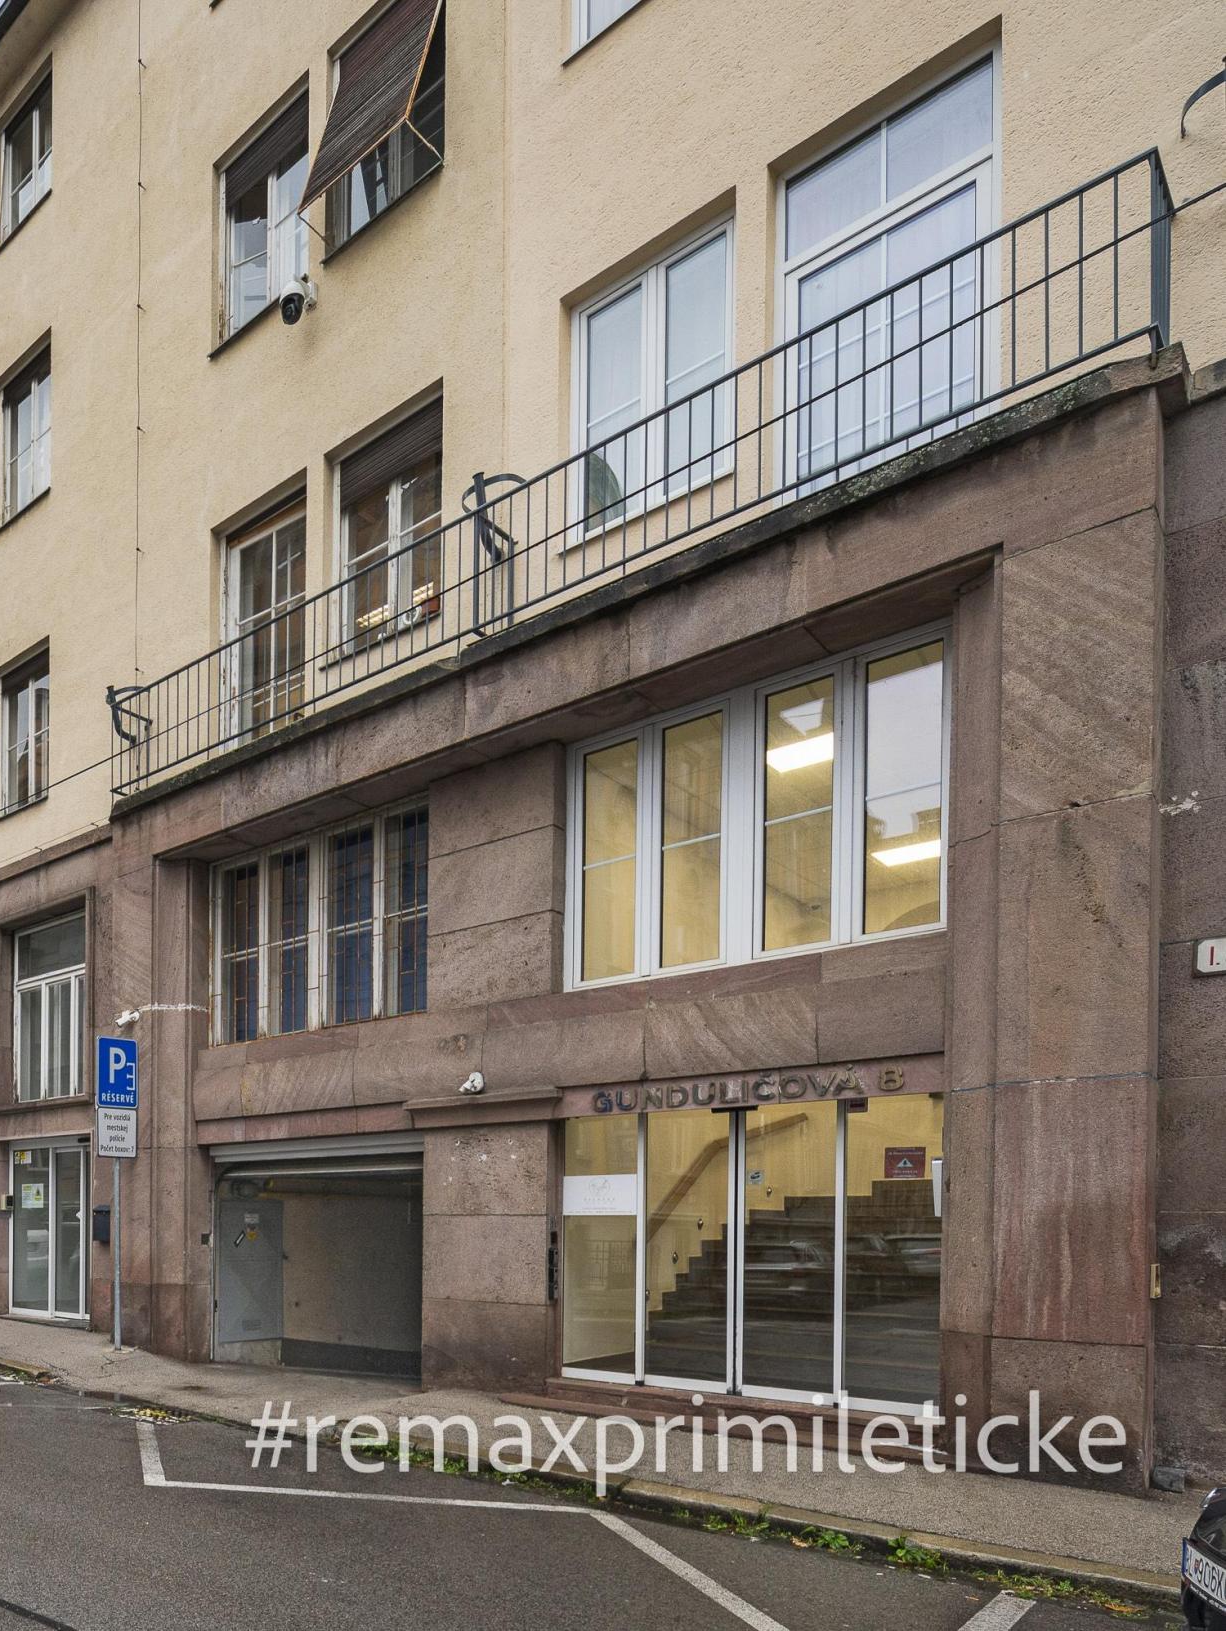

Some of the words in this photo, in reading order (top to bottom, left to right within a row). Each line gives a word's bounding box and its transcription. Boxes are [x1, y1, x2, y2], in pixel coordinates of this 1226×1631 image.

[109, 1046, 127, 1084] P
[101, 1091, 135, 1104] RÉSERVÉ
[592, 1063, 865, 1113] GUNDULIČOVÁ
